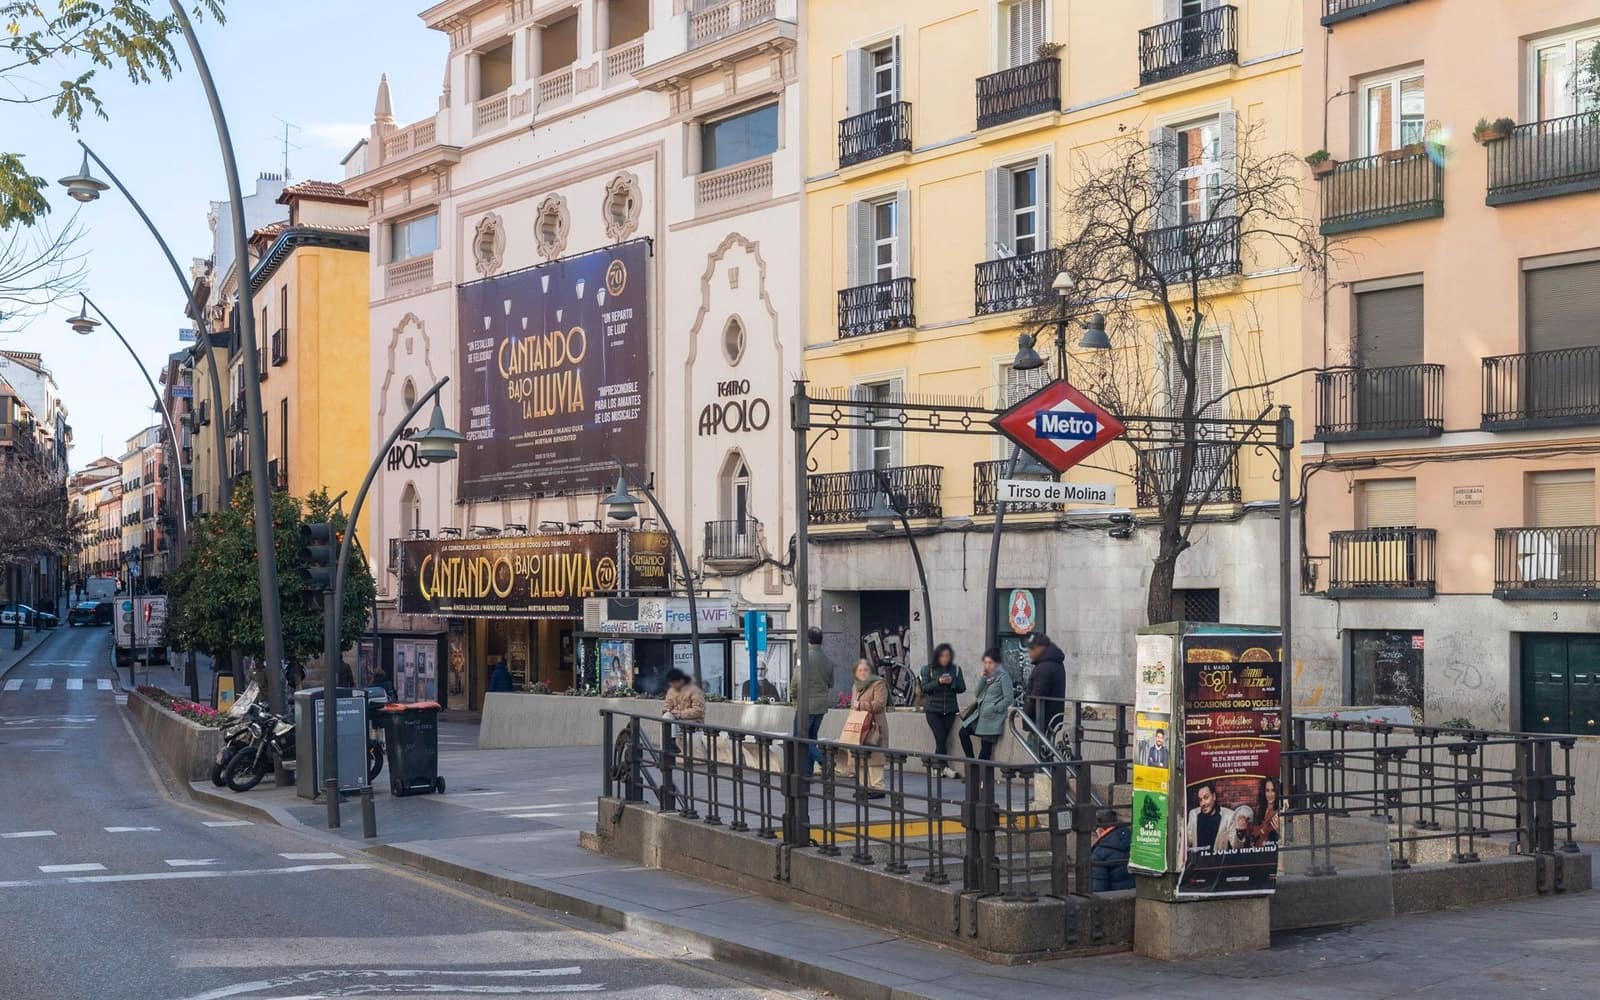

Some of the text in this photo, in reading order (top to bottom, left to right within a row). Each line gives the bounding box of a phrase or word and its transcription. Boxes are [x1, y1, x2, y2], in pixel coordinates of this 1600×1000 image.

[499, 326, 587, 380] CANTANDO
[509, 377, 533, 403] BAJO
[523, 368, 585, 420] LA LLUVIA
[717, 379, 750, 397] TEATRO
[607, 398, 617, 409] LOS
[601, 411, 611, 423] LOS
[698, 398, 770, 436] APOLO
[1041, 414, 1094, 434] Metro
[1008, 484, 1106, 500] Tirso de Molina
[515, 554, 541, 580] BAJO
[631, 554, 665, 566] CANTANDO
[419, 554, 514, 600] CANTANDO
[530, 553, 594, 598] LA LLUVIA
[665, 609, 728, 622] Free WiFi
[913, 611, 921, 622] 2
[1552, 611, 1559, 621] 3
[634, 622, 664, 632] FreeWiFi
[1194, 700, 1232, 709] OCASIONES
[1232, 699, 1251, 708] OIGO
[1252, 699, 1274, 707] VOCES
